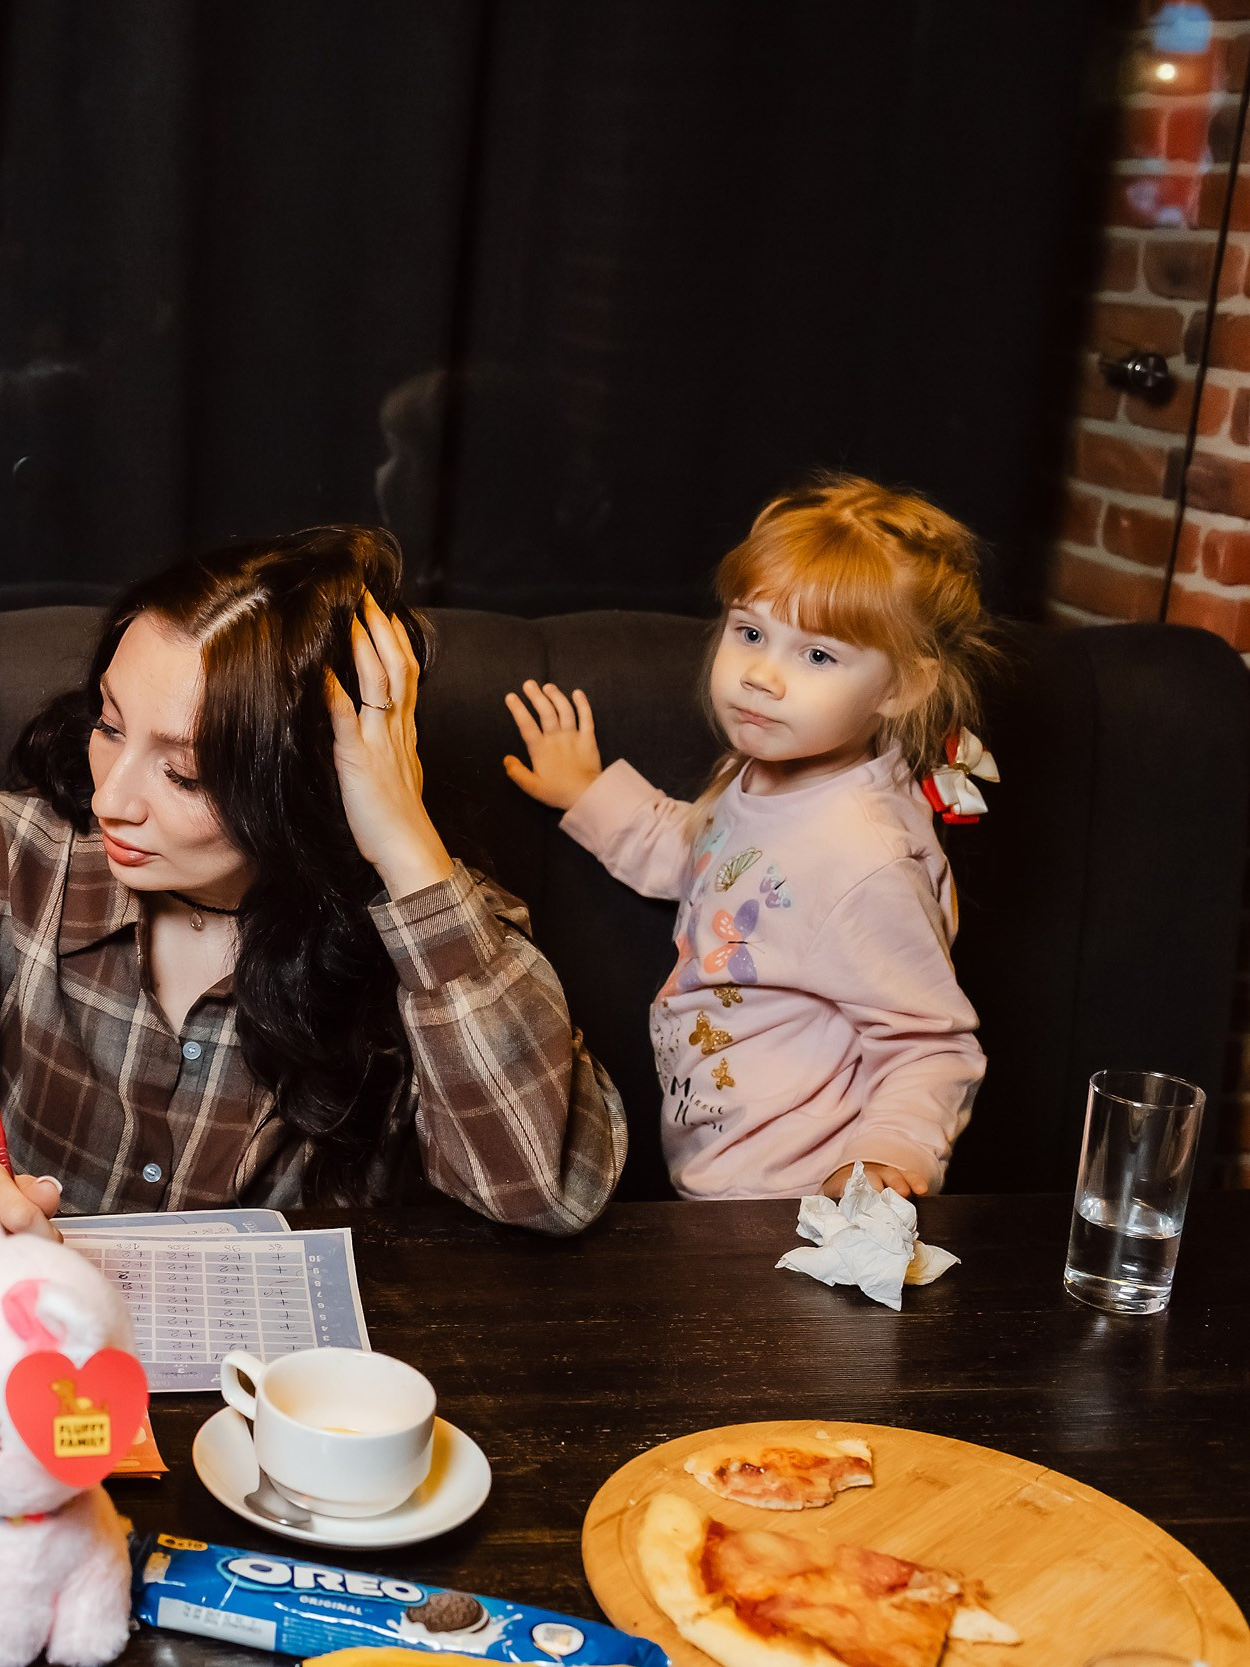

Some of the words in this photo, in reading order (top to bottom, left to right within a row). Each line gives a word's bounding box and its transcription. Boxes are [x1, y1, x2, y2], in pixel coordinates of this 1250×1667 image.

[308, 1254, 321, 1262] 10
[313, 1279, 321, 1287] 8
[59, 1437, 105, 1448] FAMILY
[228, 1557, 424, 1602] OREO
[298, 1594, 363, 1616] ORIGINAL
